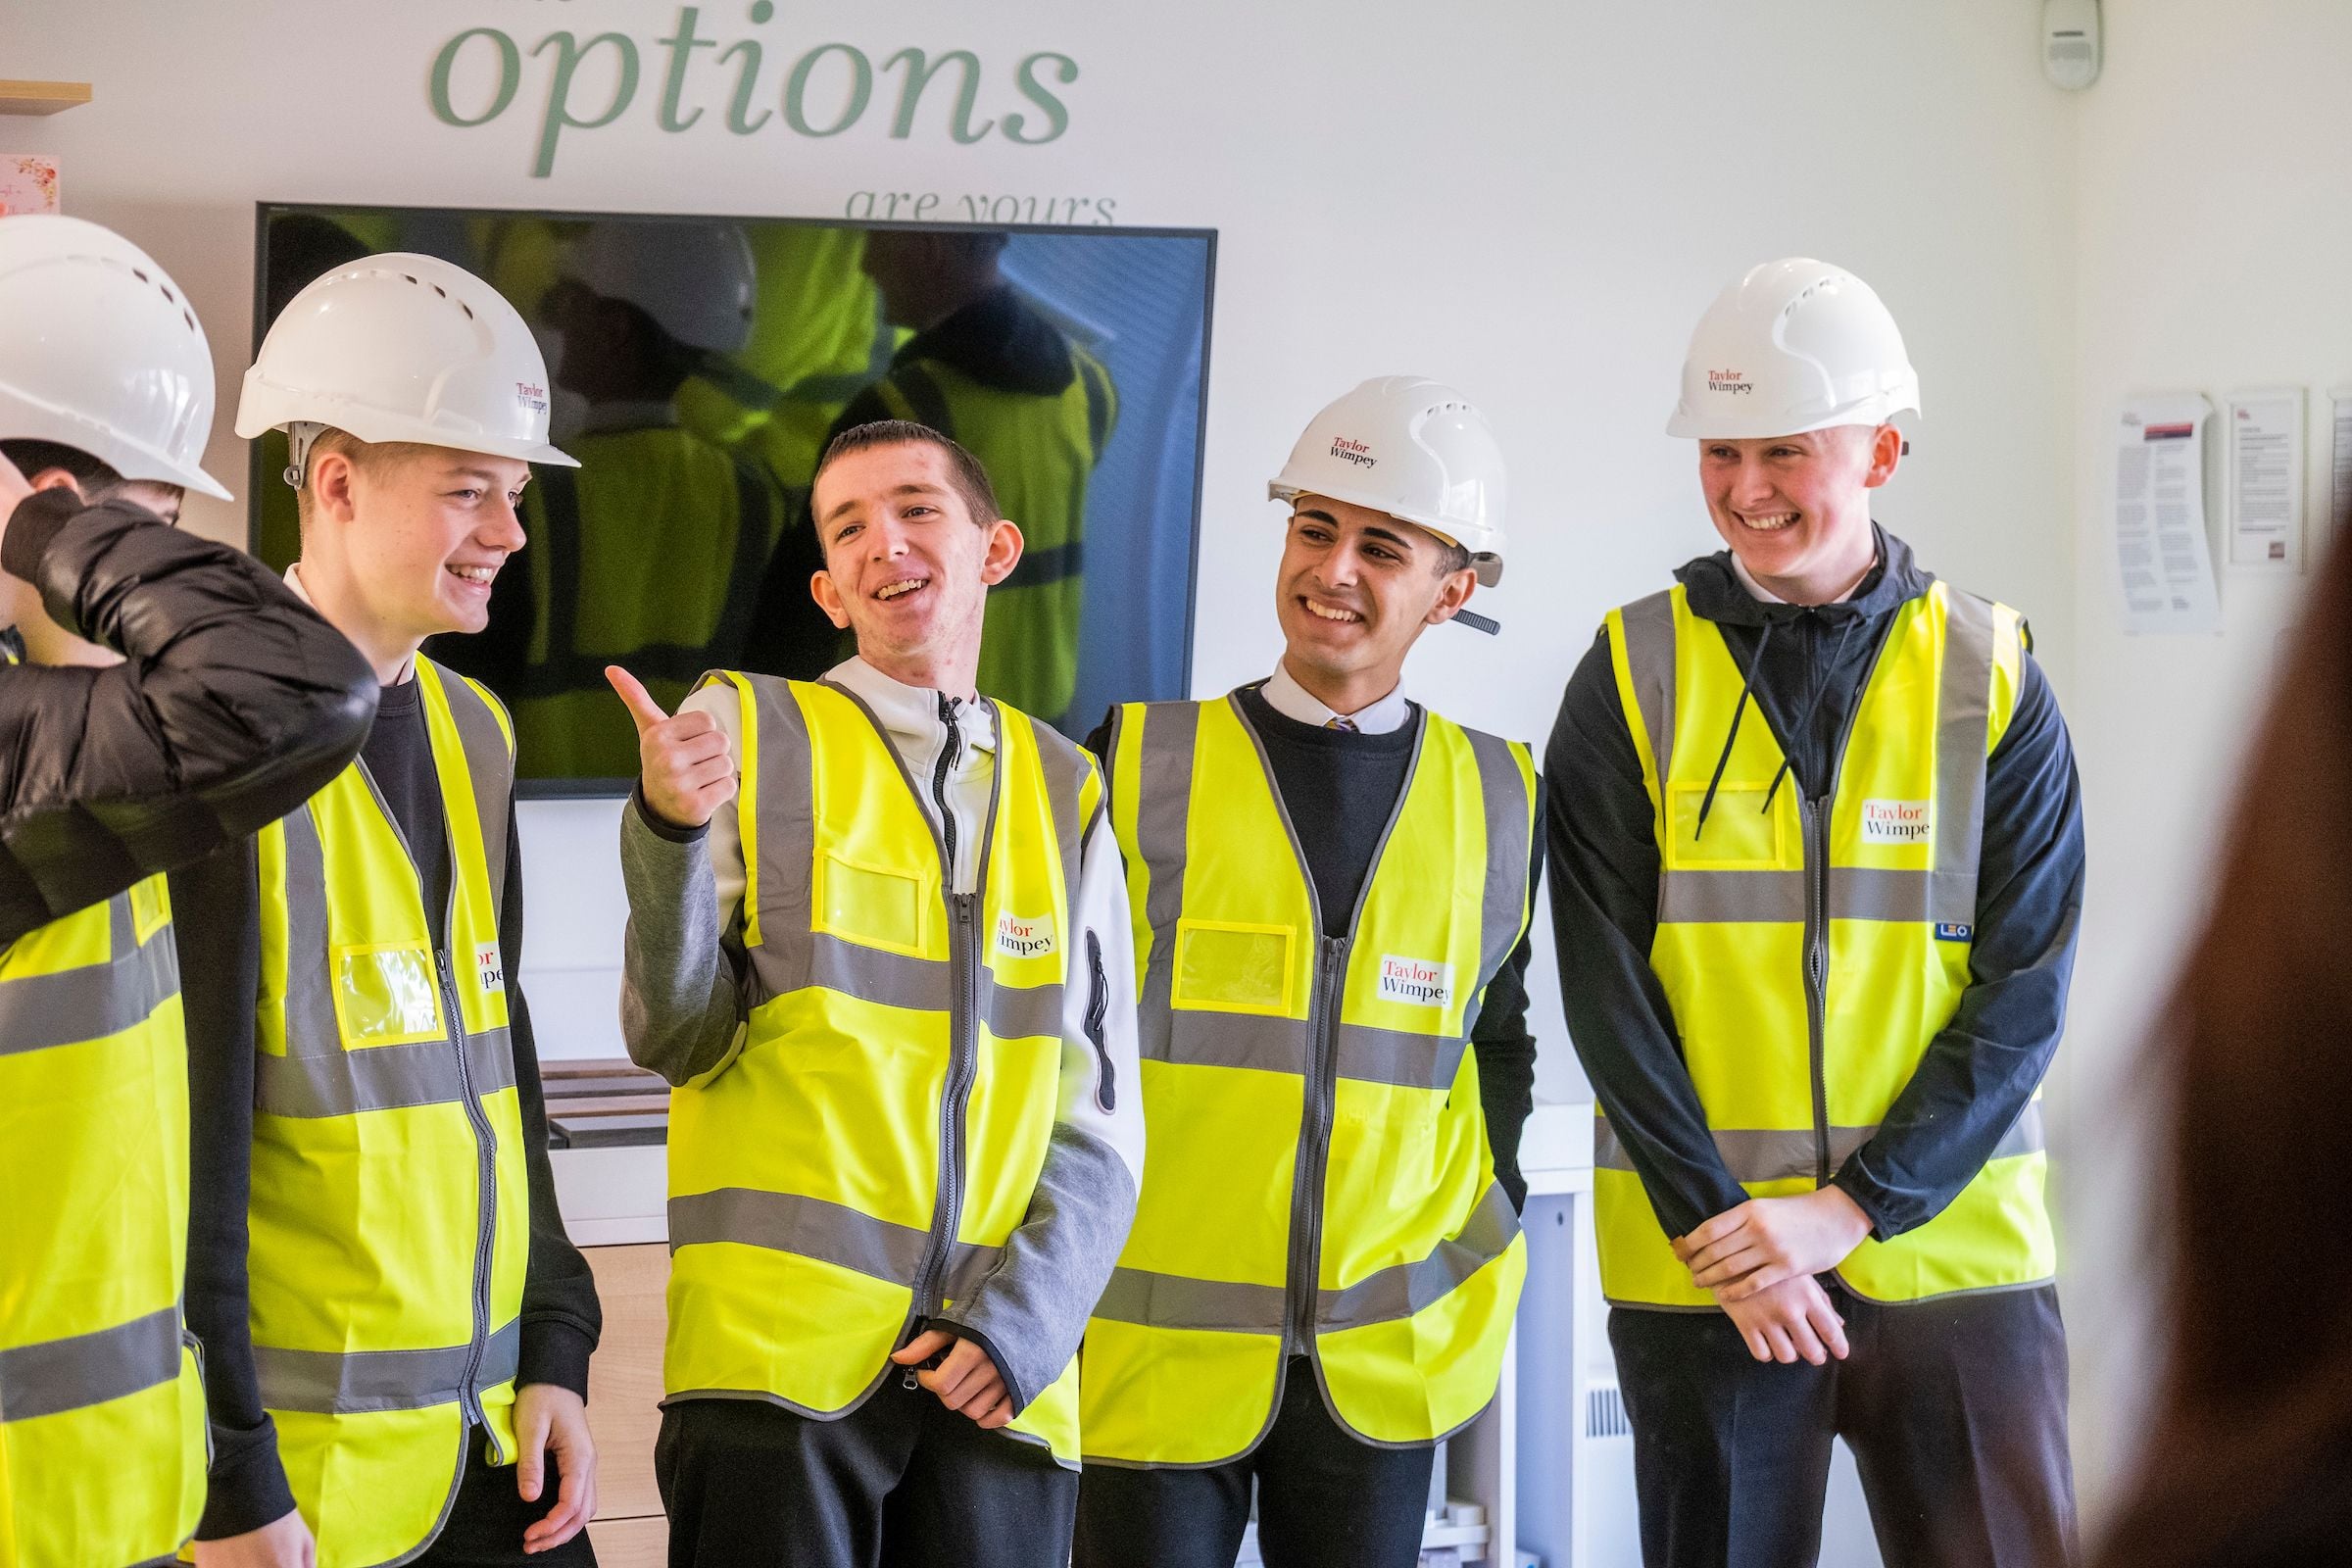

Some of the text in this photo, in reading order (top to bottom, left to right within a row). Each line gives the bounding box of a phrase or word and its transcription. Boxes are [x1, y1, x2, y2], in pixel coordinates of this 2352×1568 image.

[429, 0, 1079, 178] options
[845, 190, 939, 220] are
[1708, 368, 1742, 381] Taylor
[1708, 380, 1753, 395] Wimpey
[1333, 436, 1370, 453] Taylor
[1331, 446, 1378, 469] Wimpey
[1866, 804, 1923, 820] Taylor
[997, 930, 1054, 956] impey
[1384, 959, 1439, 982] Taylor
[1383, 976, 1450, 1004] Wimpey
